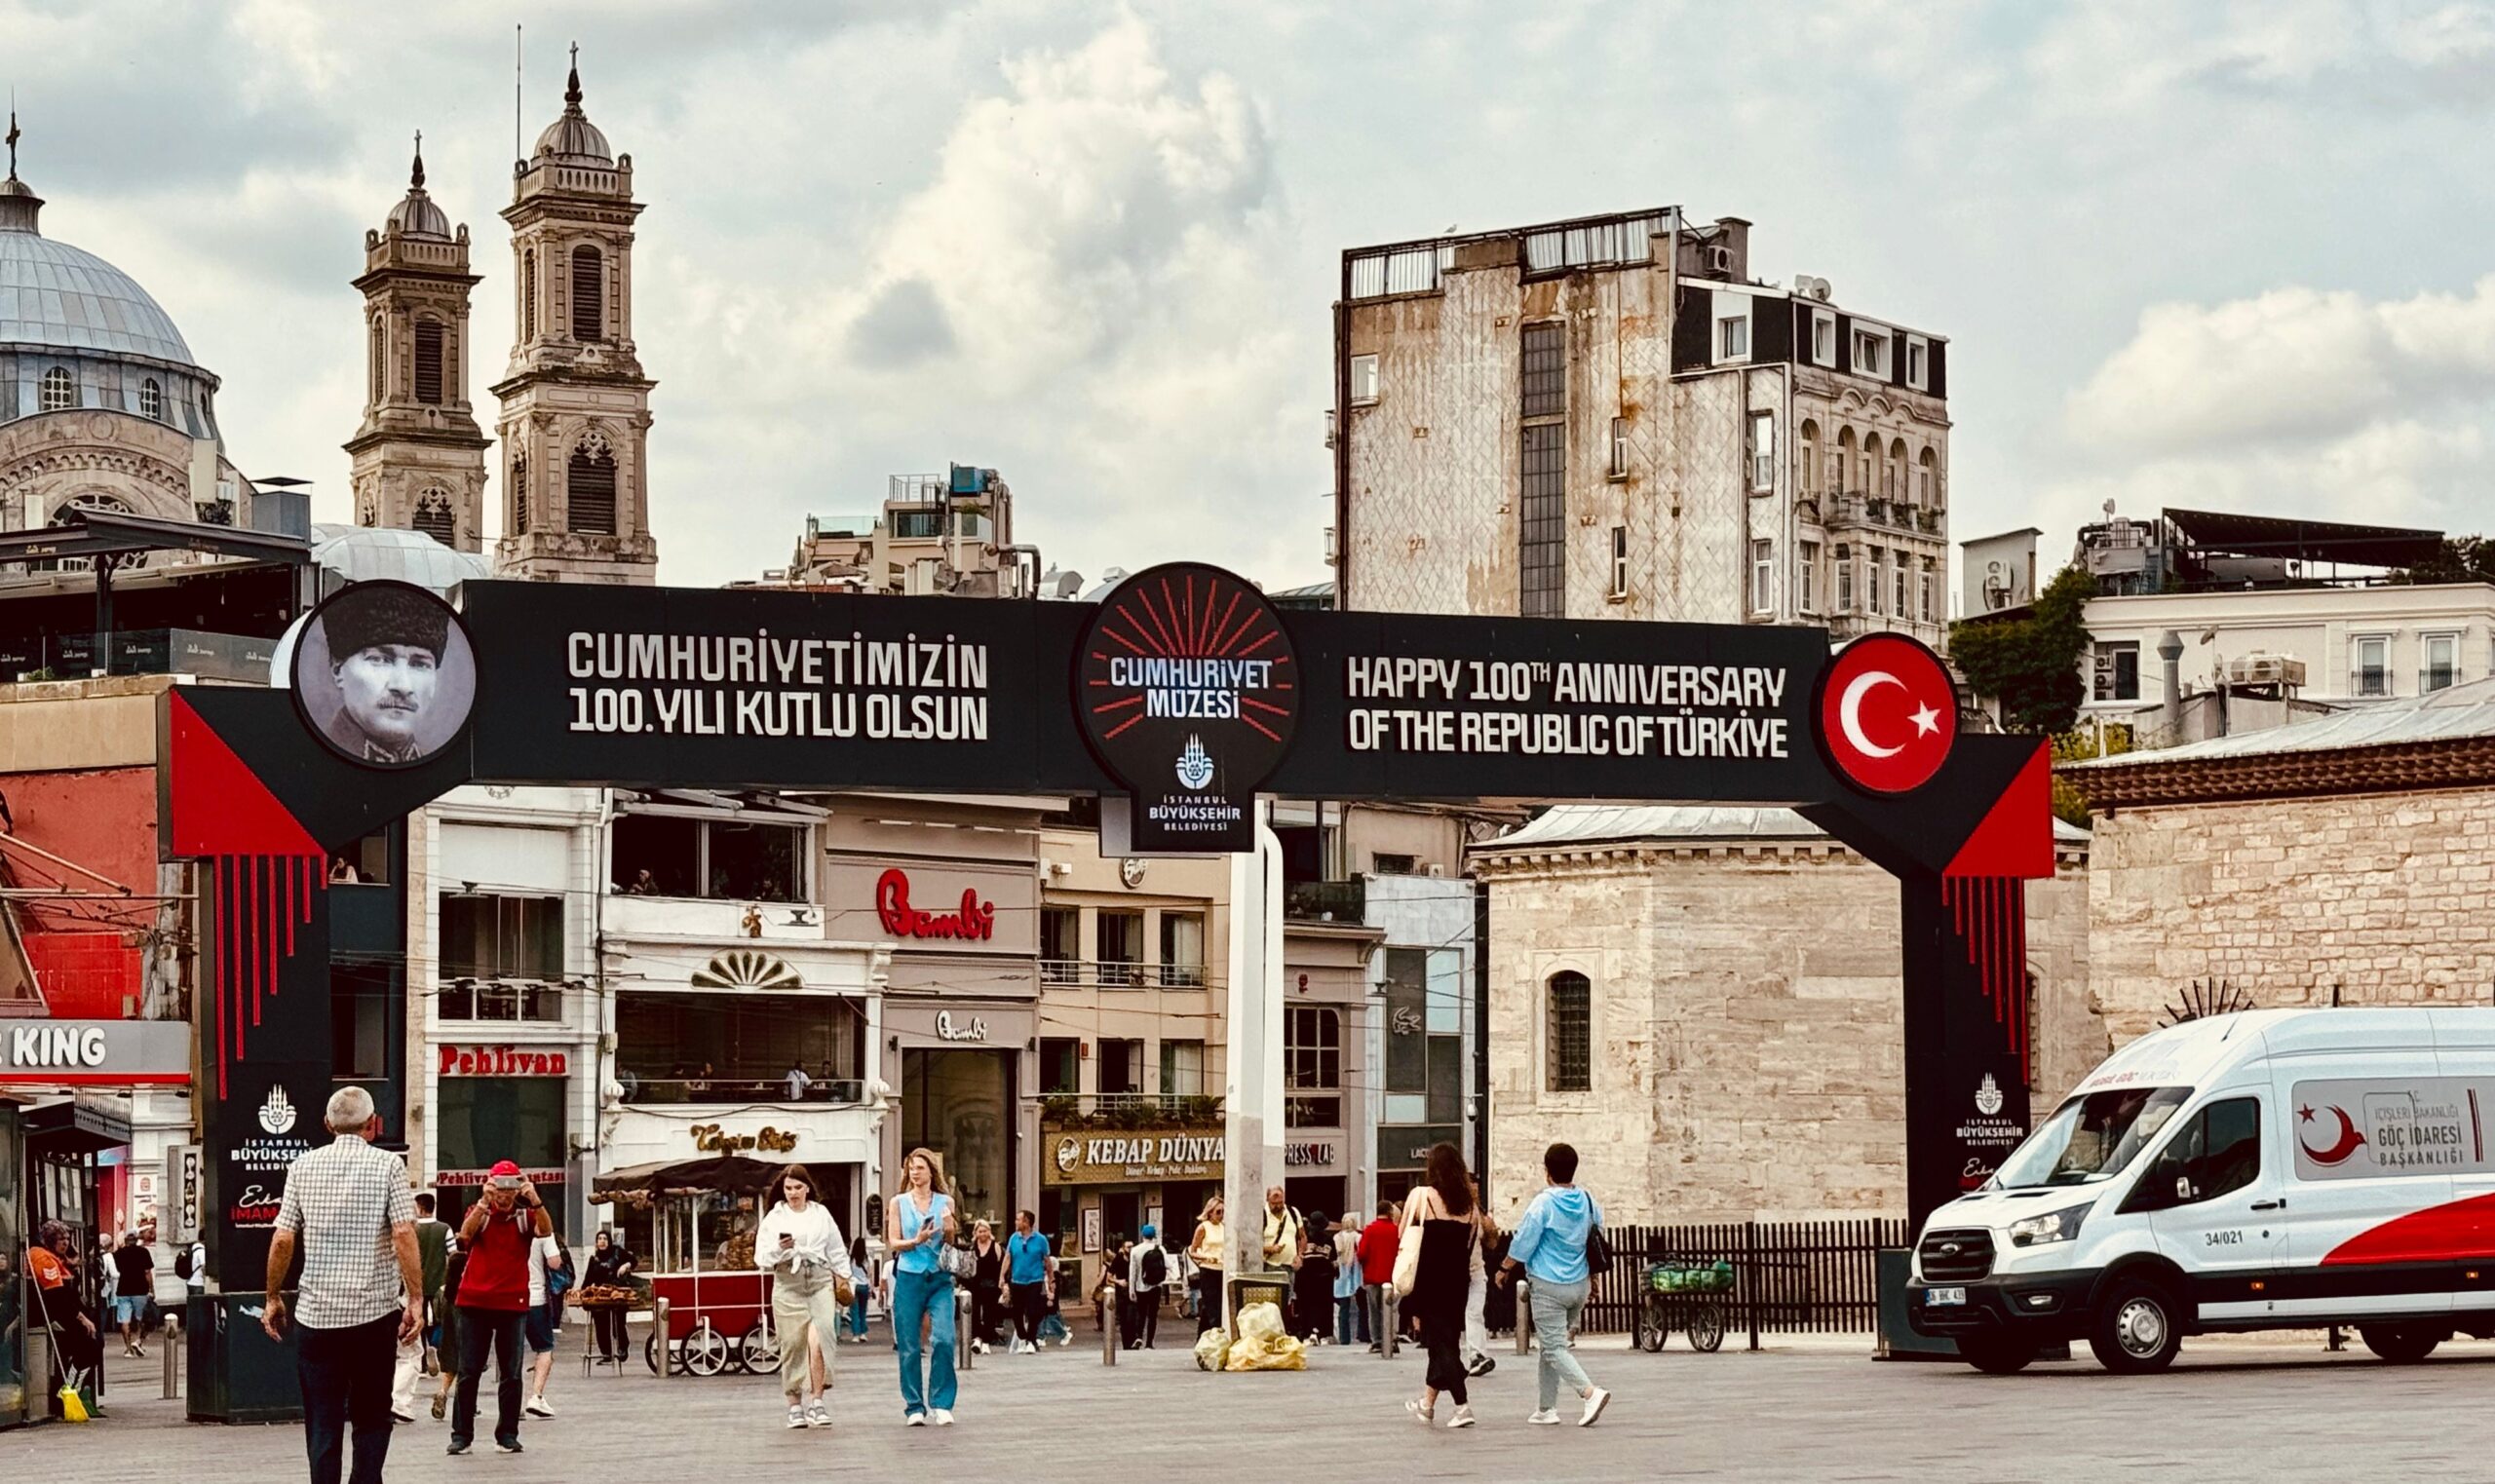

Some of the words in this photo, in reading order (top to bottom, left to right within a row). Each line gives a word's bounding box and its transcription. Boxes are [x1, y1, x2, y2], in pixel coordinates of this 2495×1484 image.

[568, 628, 988, 688] CUMHURİYETİMİZİN
[1110, 657, 1273, 689] CUMHURİYET
[1348, 657, 1461, 700] HAPPY
[1555, 663, 1785, 707] ANNIVERSARY
[736, 690, 856, 738] KUTLU
[866, 694, 987, 741] OLSUN
[1146, 689, 1240, 719] MÜZESİ
[1349, 708, 1390, 750] OF
[1393, 710, 1455, 751] THE
[1461, 712, 1609, 755] REPUBLIC
[1616, 715, 1654, 756] OF
[1656, 708, 1788, 758] TÜRKİYE
[1149, 805, 1241, 821] BÜYÜKŞEHİR
[1163, 794, 1227, 805] İSTANBUL
[1164, 822, 1228, 831] BELEDİYESİ
[877, 868, 994, 940] Bambi
[937, 1010, 987, 1041] Bambi
[14, 1027, 106, 1066] KING
[439, 1046, 566, 1075] Pehlivan
[246, 1138, 309, 1147] İSTANBUL
[1956, 1125, 2023, 1137] BÜYÜKŞEHİR
[2378, 1124, 2405, 1150] GÖÇ
[2408, 1122, 2463, 1146] İDARESİ
[1086, 1138, 1153, 1164] KEBAP
[1158, 1133, 1225, 1162] DÜNYA
[2380, 1147, 2464, 1169] BAŞKANLIĞI
[440, 1172, 488, 1185] Pehliva
[2205, 1230, 2243, 1246] 34/021
